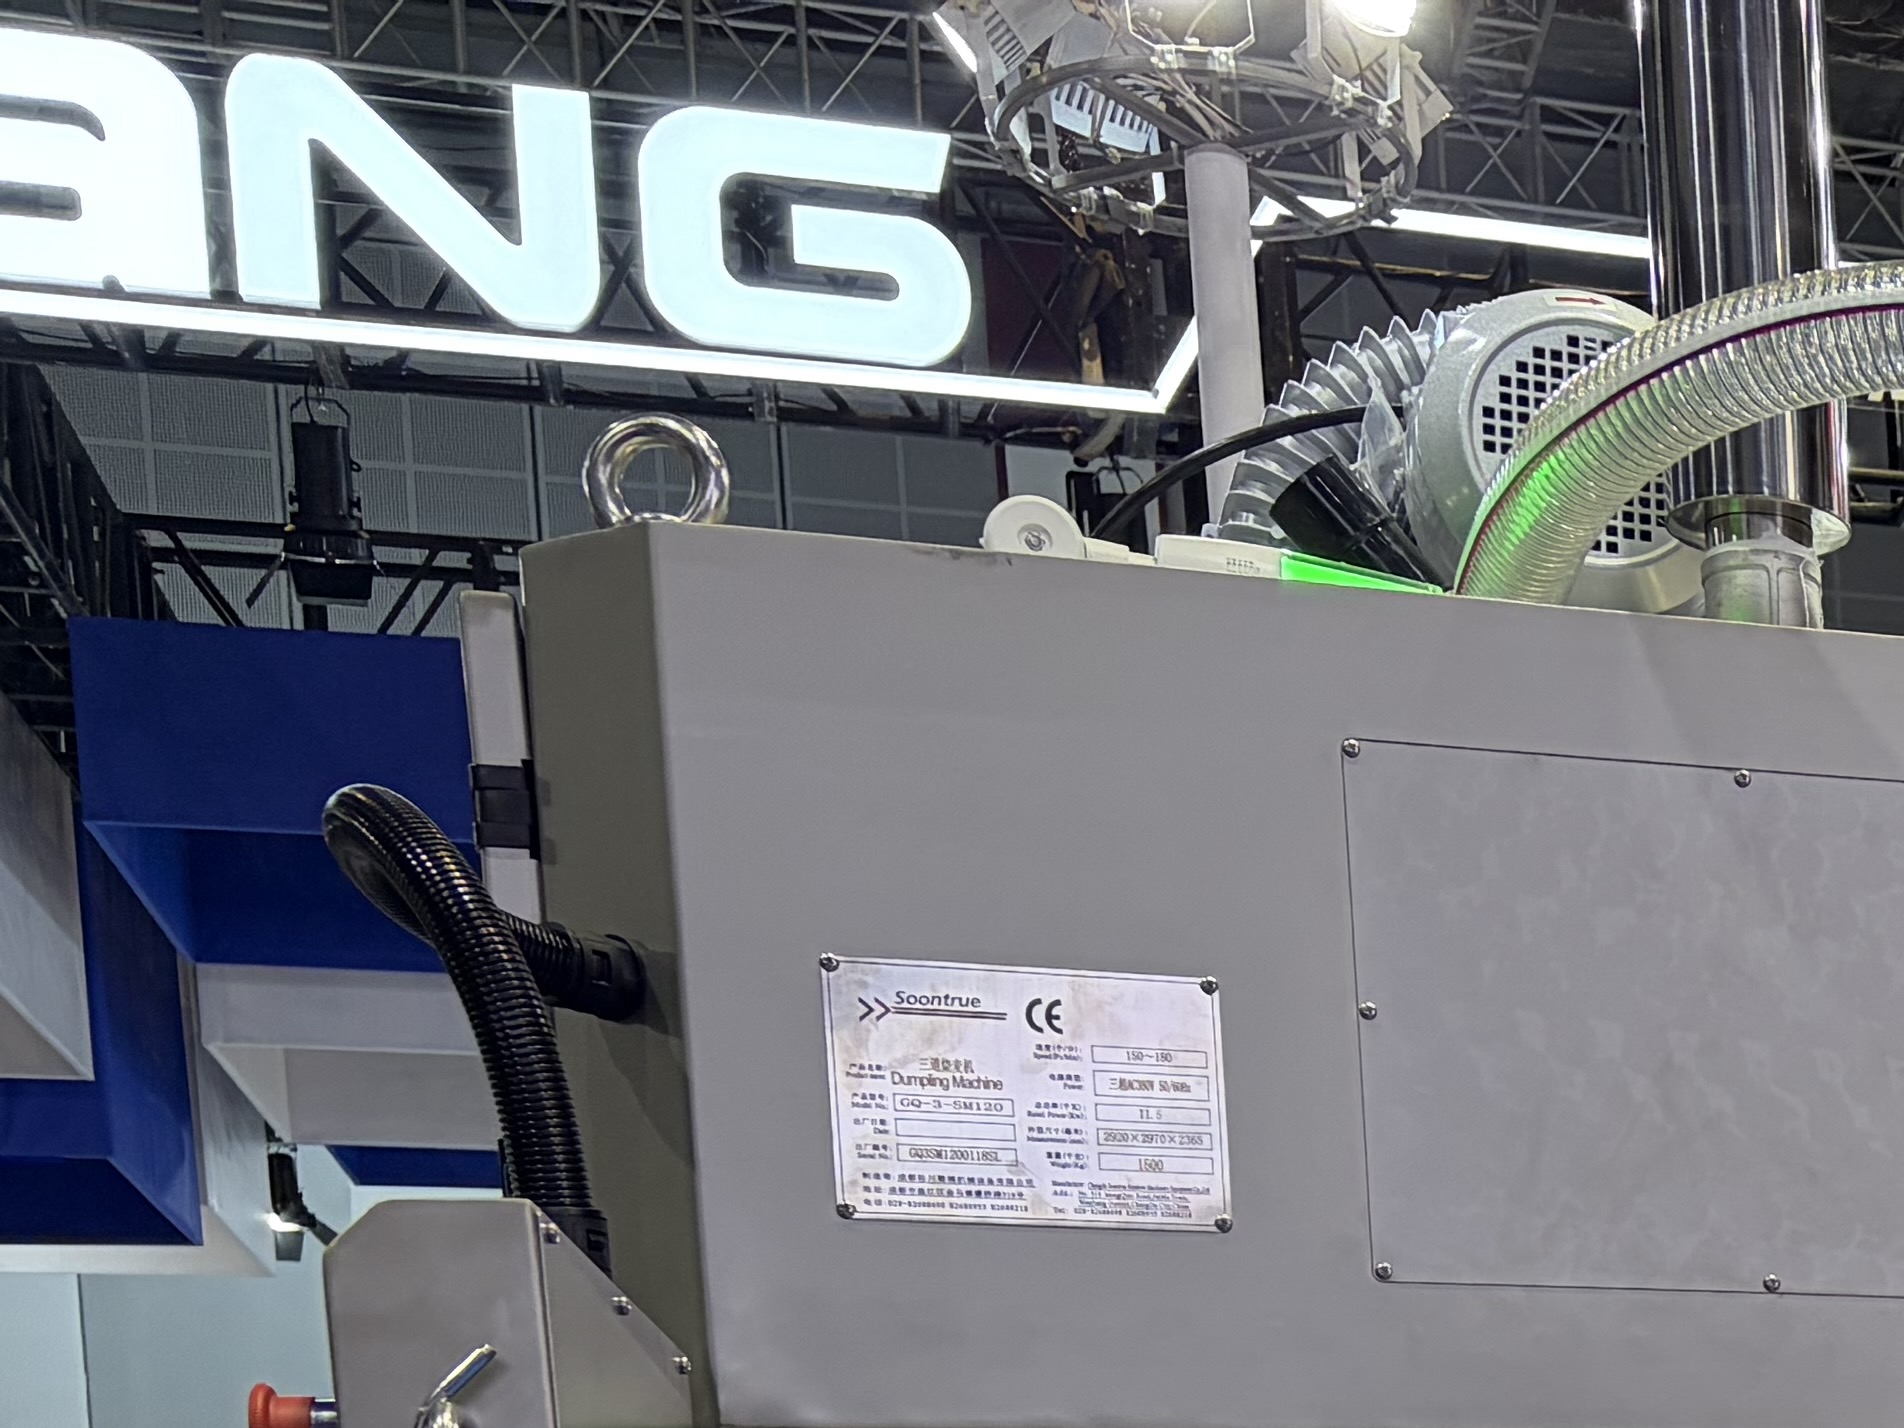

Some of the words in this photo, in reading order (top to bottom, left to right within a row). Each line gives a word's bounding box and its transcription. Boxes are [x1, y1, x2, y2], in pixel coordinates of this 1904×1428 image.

[893, 990, 982, 1008] Soontrue
[891, 1071, 950, 1091] Dumpling
[952, 1075, 1004, 1091] Machine
